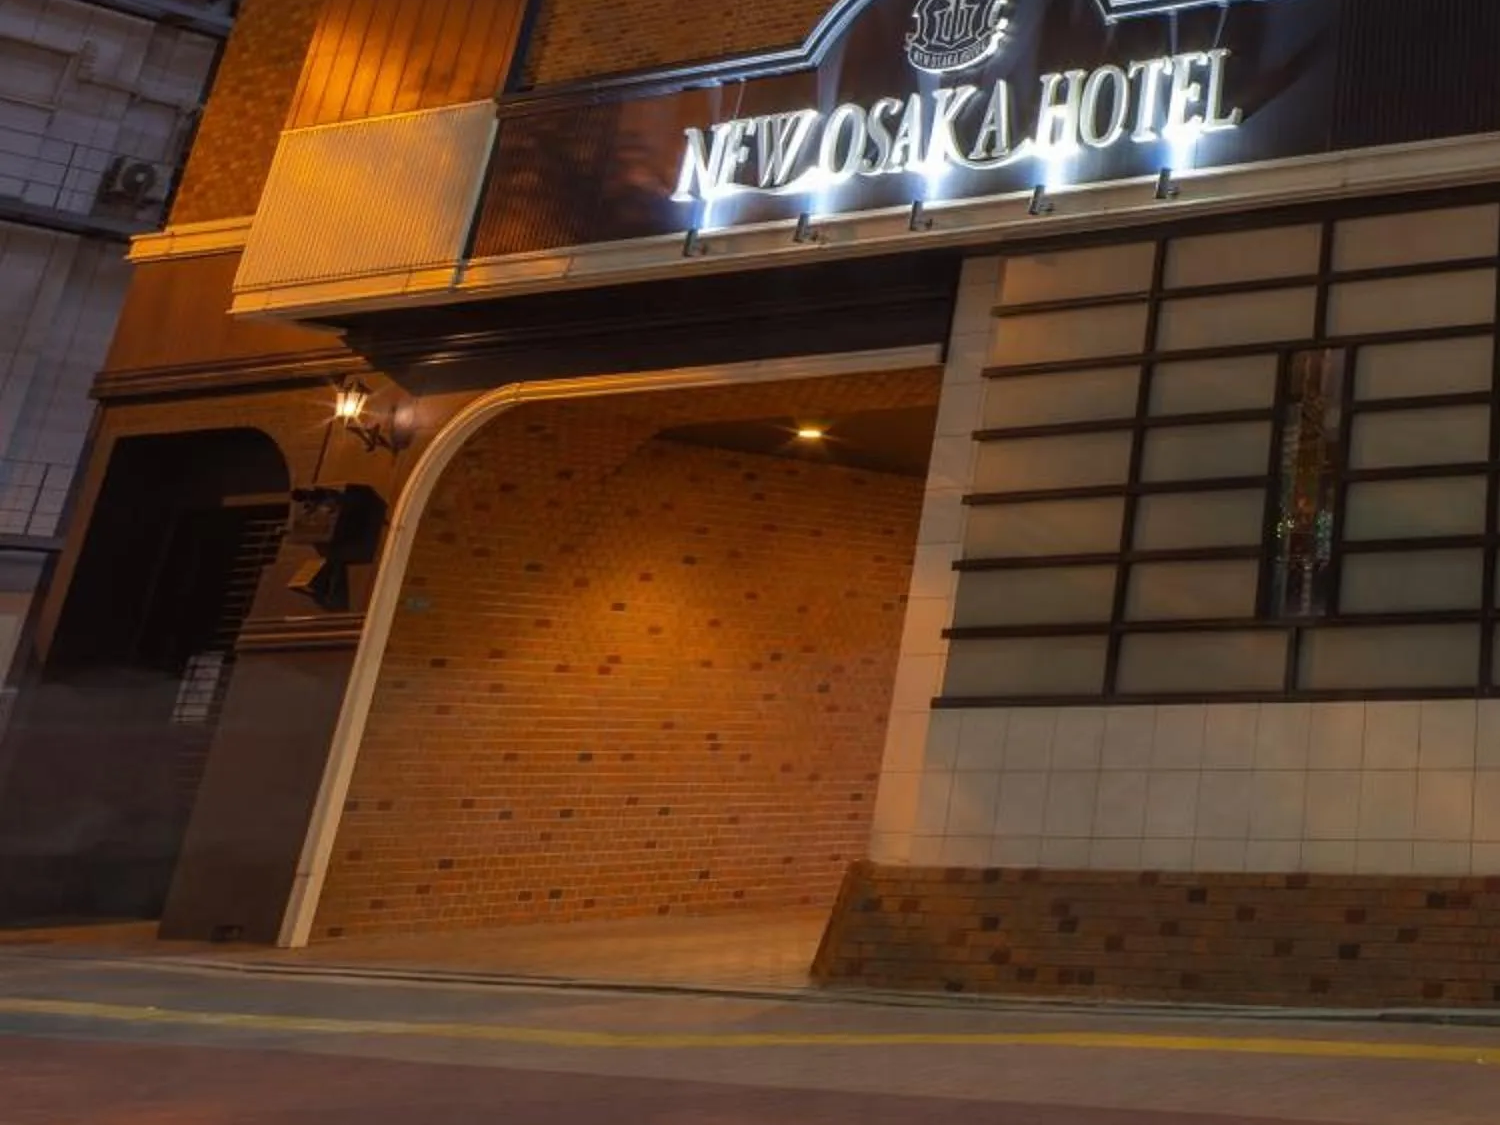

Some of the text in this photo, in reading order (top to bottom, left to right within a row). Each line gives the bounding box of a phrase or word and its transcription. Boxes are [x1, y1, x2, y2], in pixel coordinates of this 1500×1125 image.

[670, 48, 1243, 202] NEW OSAKA HOTEL
